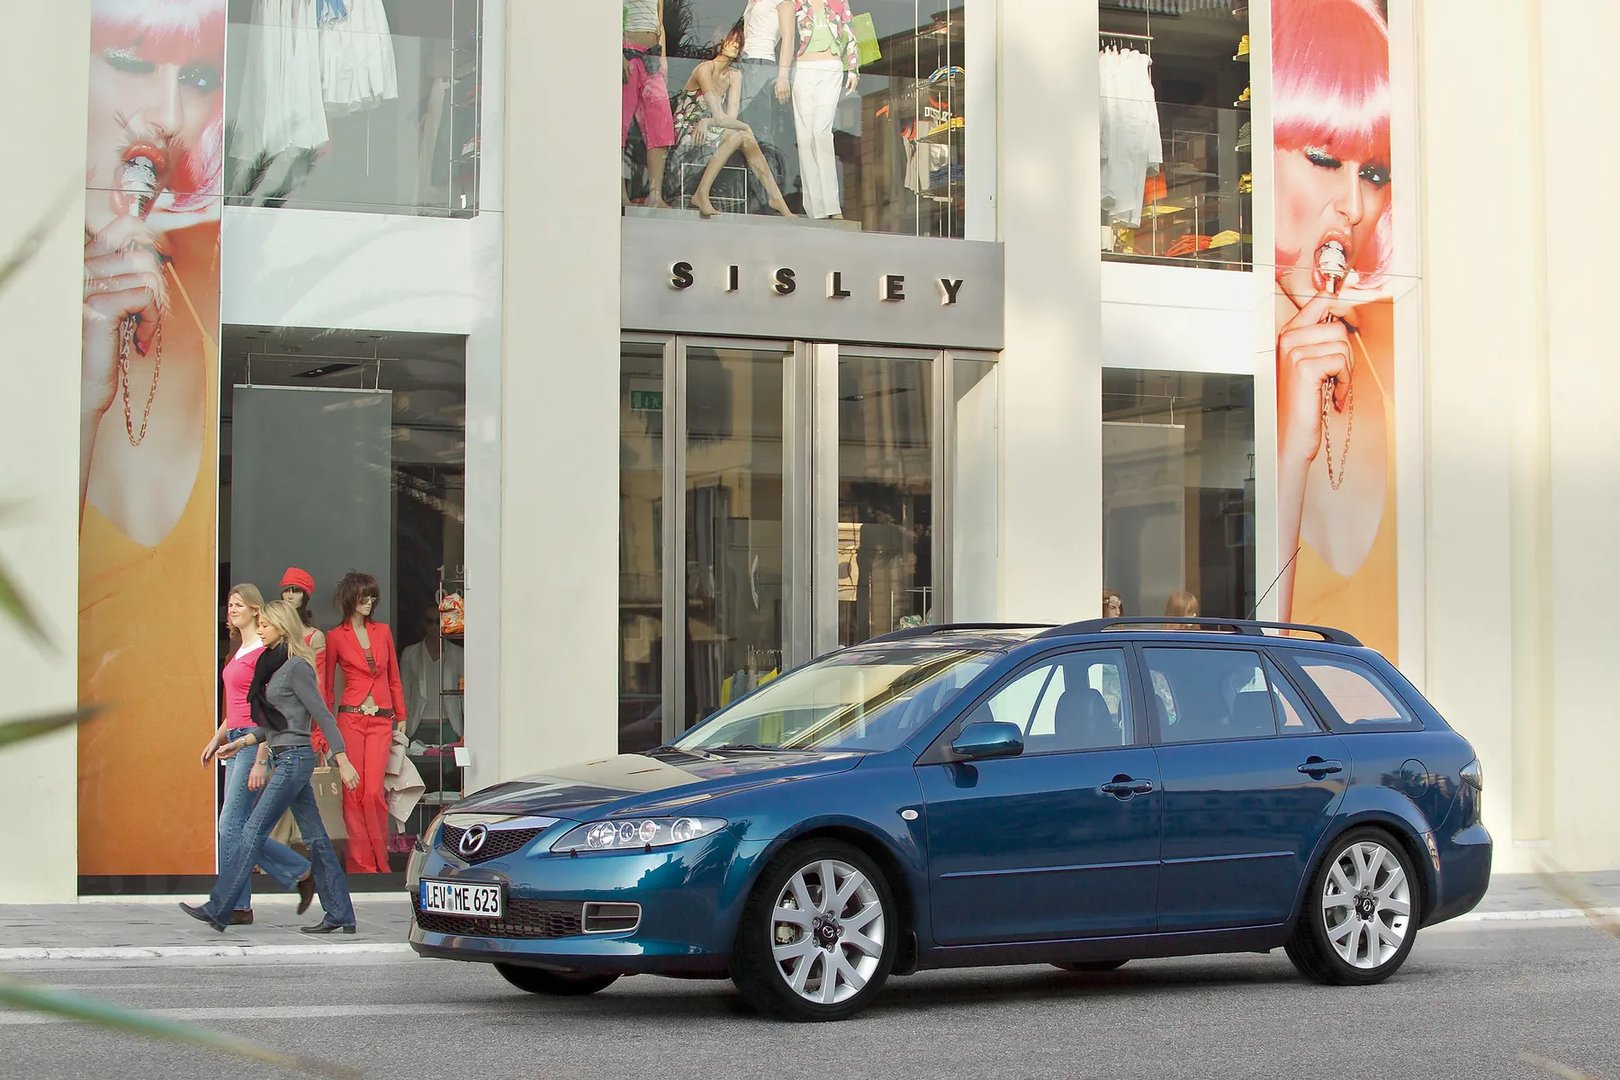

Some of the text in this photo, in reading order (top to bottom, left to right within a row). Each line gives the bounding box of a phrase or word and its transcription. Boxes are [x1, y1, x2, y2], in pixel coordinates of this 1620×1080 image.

[669, 261, 964, 304] SISLEY
[427, 885, 498, 913] LEV ME 623
